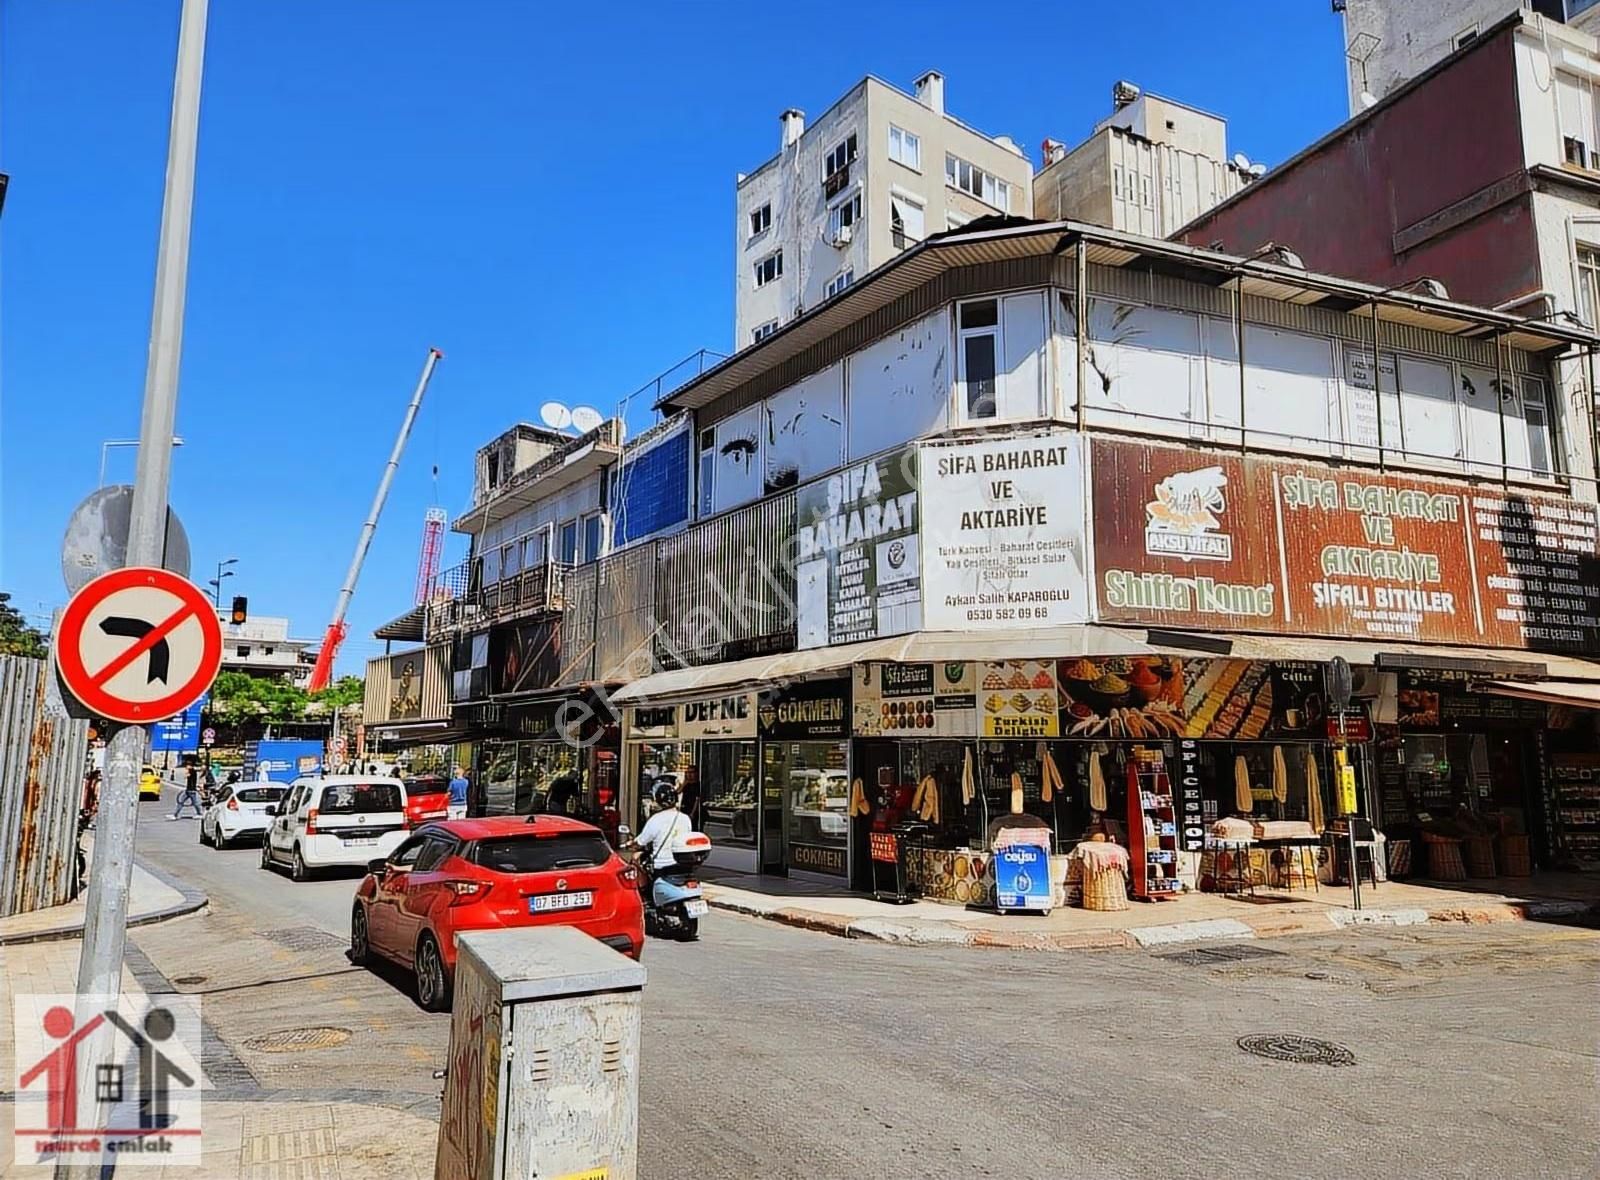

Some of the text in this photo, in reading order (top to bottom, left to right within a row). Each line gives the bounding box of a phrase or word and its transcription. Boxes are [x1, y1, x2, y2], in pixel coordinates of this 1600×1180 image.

[938, 447, 1067, 478] ŞİFA BAHARAT
[992, 480, 1013, 499] VE
[1282, 470, 1460, 523] ŞİFA BAHARAT
[799, 491, 917, 558] BAHARAT
[961, 504, 1047, 530] AKTARİYE
[1361, 515, 1395, 546] VE
[1000, 541, 1034, 552] Baharat
[1321, 544, 1441, 584] AKTARİYE
[1105, 569, 1275, 617] Shiffa Home
[1312, 577, 1456, 615] ŞİFALI BİTKİLER
[967, 609, 992, 621] 0530
[995, 608, 1015, 620] 582
[685, 696, 750, 723] DEFNE
[778, 697, 844, 723] GÖKMEN
[993, 717, 1049, 726] Turkish
[994, 726, 1046, 736] Delight
[536, 898, 547, 908] 07
